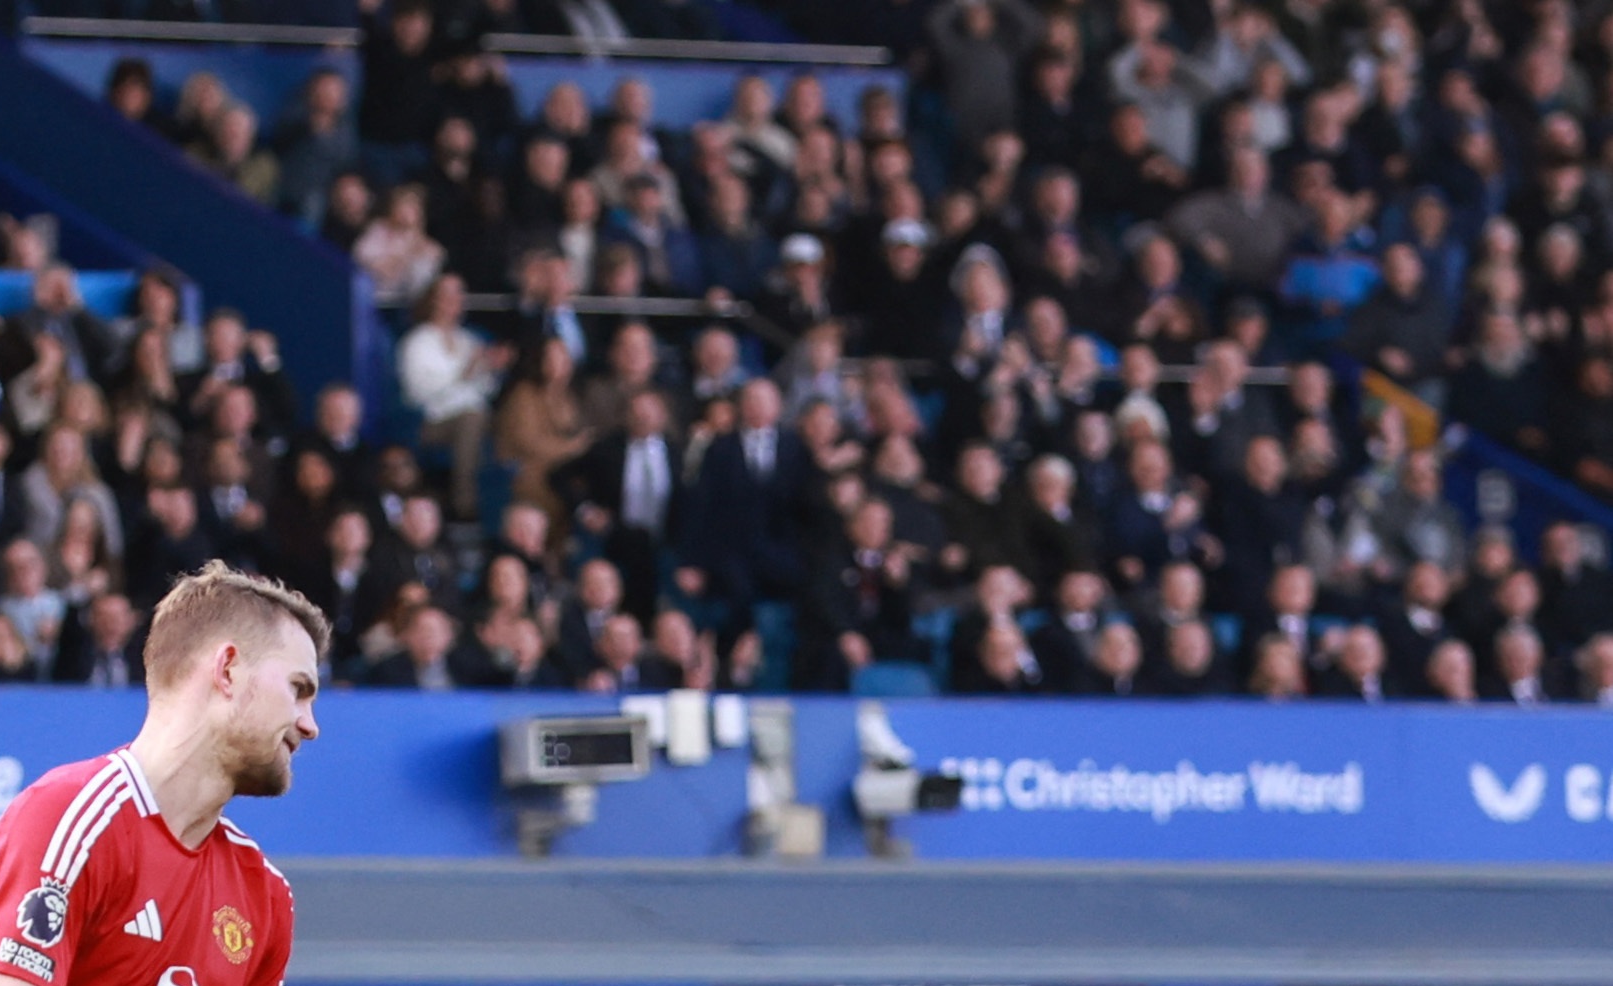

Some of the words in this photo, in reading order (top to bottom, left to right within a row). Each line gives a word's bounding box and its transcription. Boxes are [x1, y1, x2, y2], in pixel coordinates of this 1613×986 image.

[1004, 757, 1247, 824] Christopher
[1248, 761, 1363, 814] Ward
[12, 954, 54, 984] racism
[17, 945, 53, 971] room
